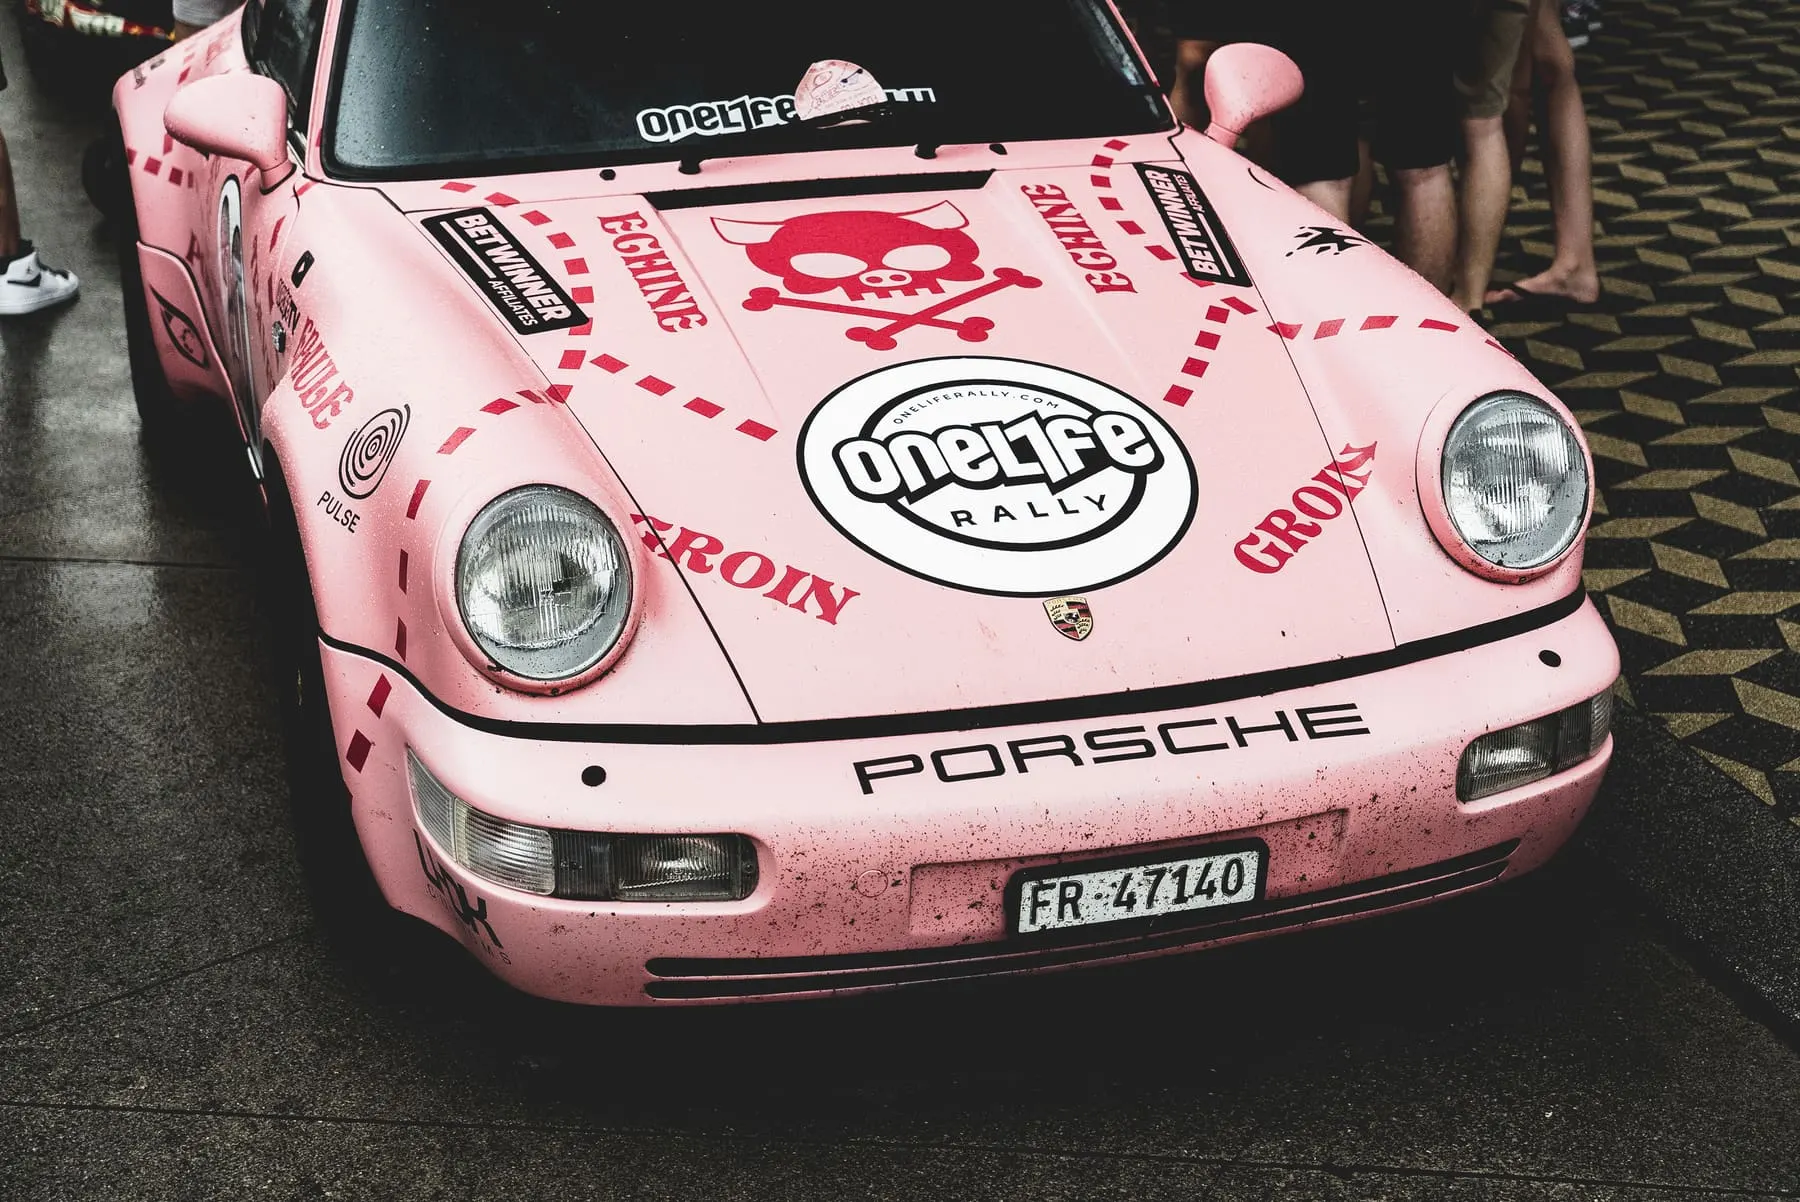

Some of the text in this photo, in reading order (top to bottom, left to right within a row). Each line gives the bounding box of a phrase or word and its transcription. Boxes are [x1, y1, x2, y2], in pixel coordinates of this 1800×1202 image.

[454, 213, 572, 322] BETWINNER
[597, 211, 708, 333] ECHINE
[1020, 184, 1138, 294] ECHINE
[1144, 169, 1222, 276] BETWINNER
[488, 280, 539, 327] AFFILIATES
[893, 390, 1059, 425] ONELIFERALLY.COM
[316, 490, 361, 534] PULSE
[950, 494, 1106, 527] RALLY
[1234, 440, 1378, 574] GROIN
[853, 702, 1371, 795] PORSCHE
